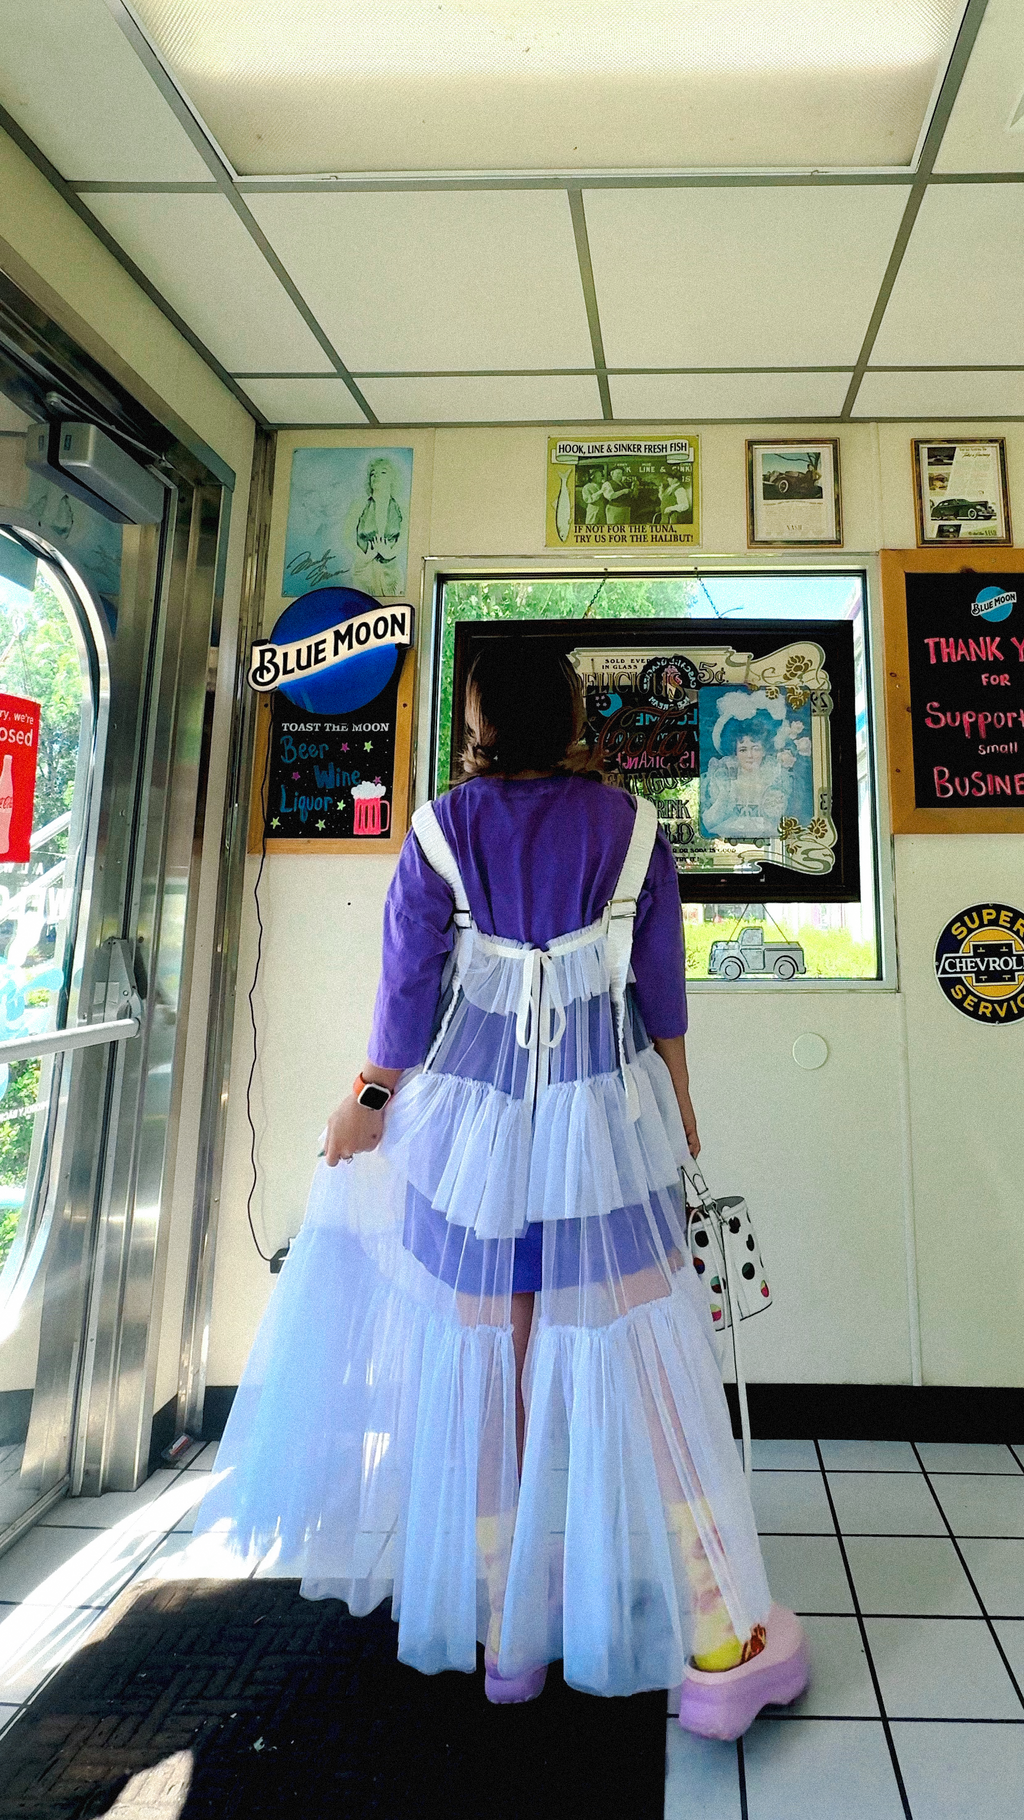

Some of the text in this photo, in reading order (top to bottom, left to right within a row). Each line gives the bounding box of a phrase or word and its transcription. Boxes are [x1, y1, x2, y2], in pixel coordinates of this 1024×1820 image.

[558, 442, 687, 454] HOOK, LINE & SINKER FRESH FISH
[574, 525, 583, 533] IF
[585, 525, 604, 533] NOT
[607, 525, 626, 533] FOR
[628, 525, 647, 533] THE
[574, 534, 694, 543] TRY US FOR THE HALIBUT!
[972, 593, 1016, 615] BLUE MOON
[252, 612, 406, 686] BLUE MOON
[924, 636, 1004, 664] THANK
[981, 673, 1011, 686] FOR
[14, 712, 34, 725] we're
[282, 723, 390, 732] TOAST THE MOON
[280, 735, 329, 763] Beer
[978, 741, 1018, 755] small
[313, 762, 361, 789] Wine
[280, 784, 333, 824] Liquor
